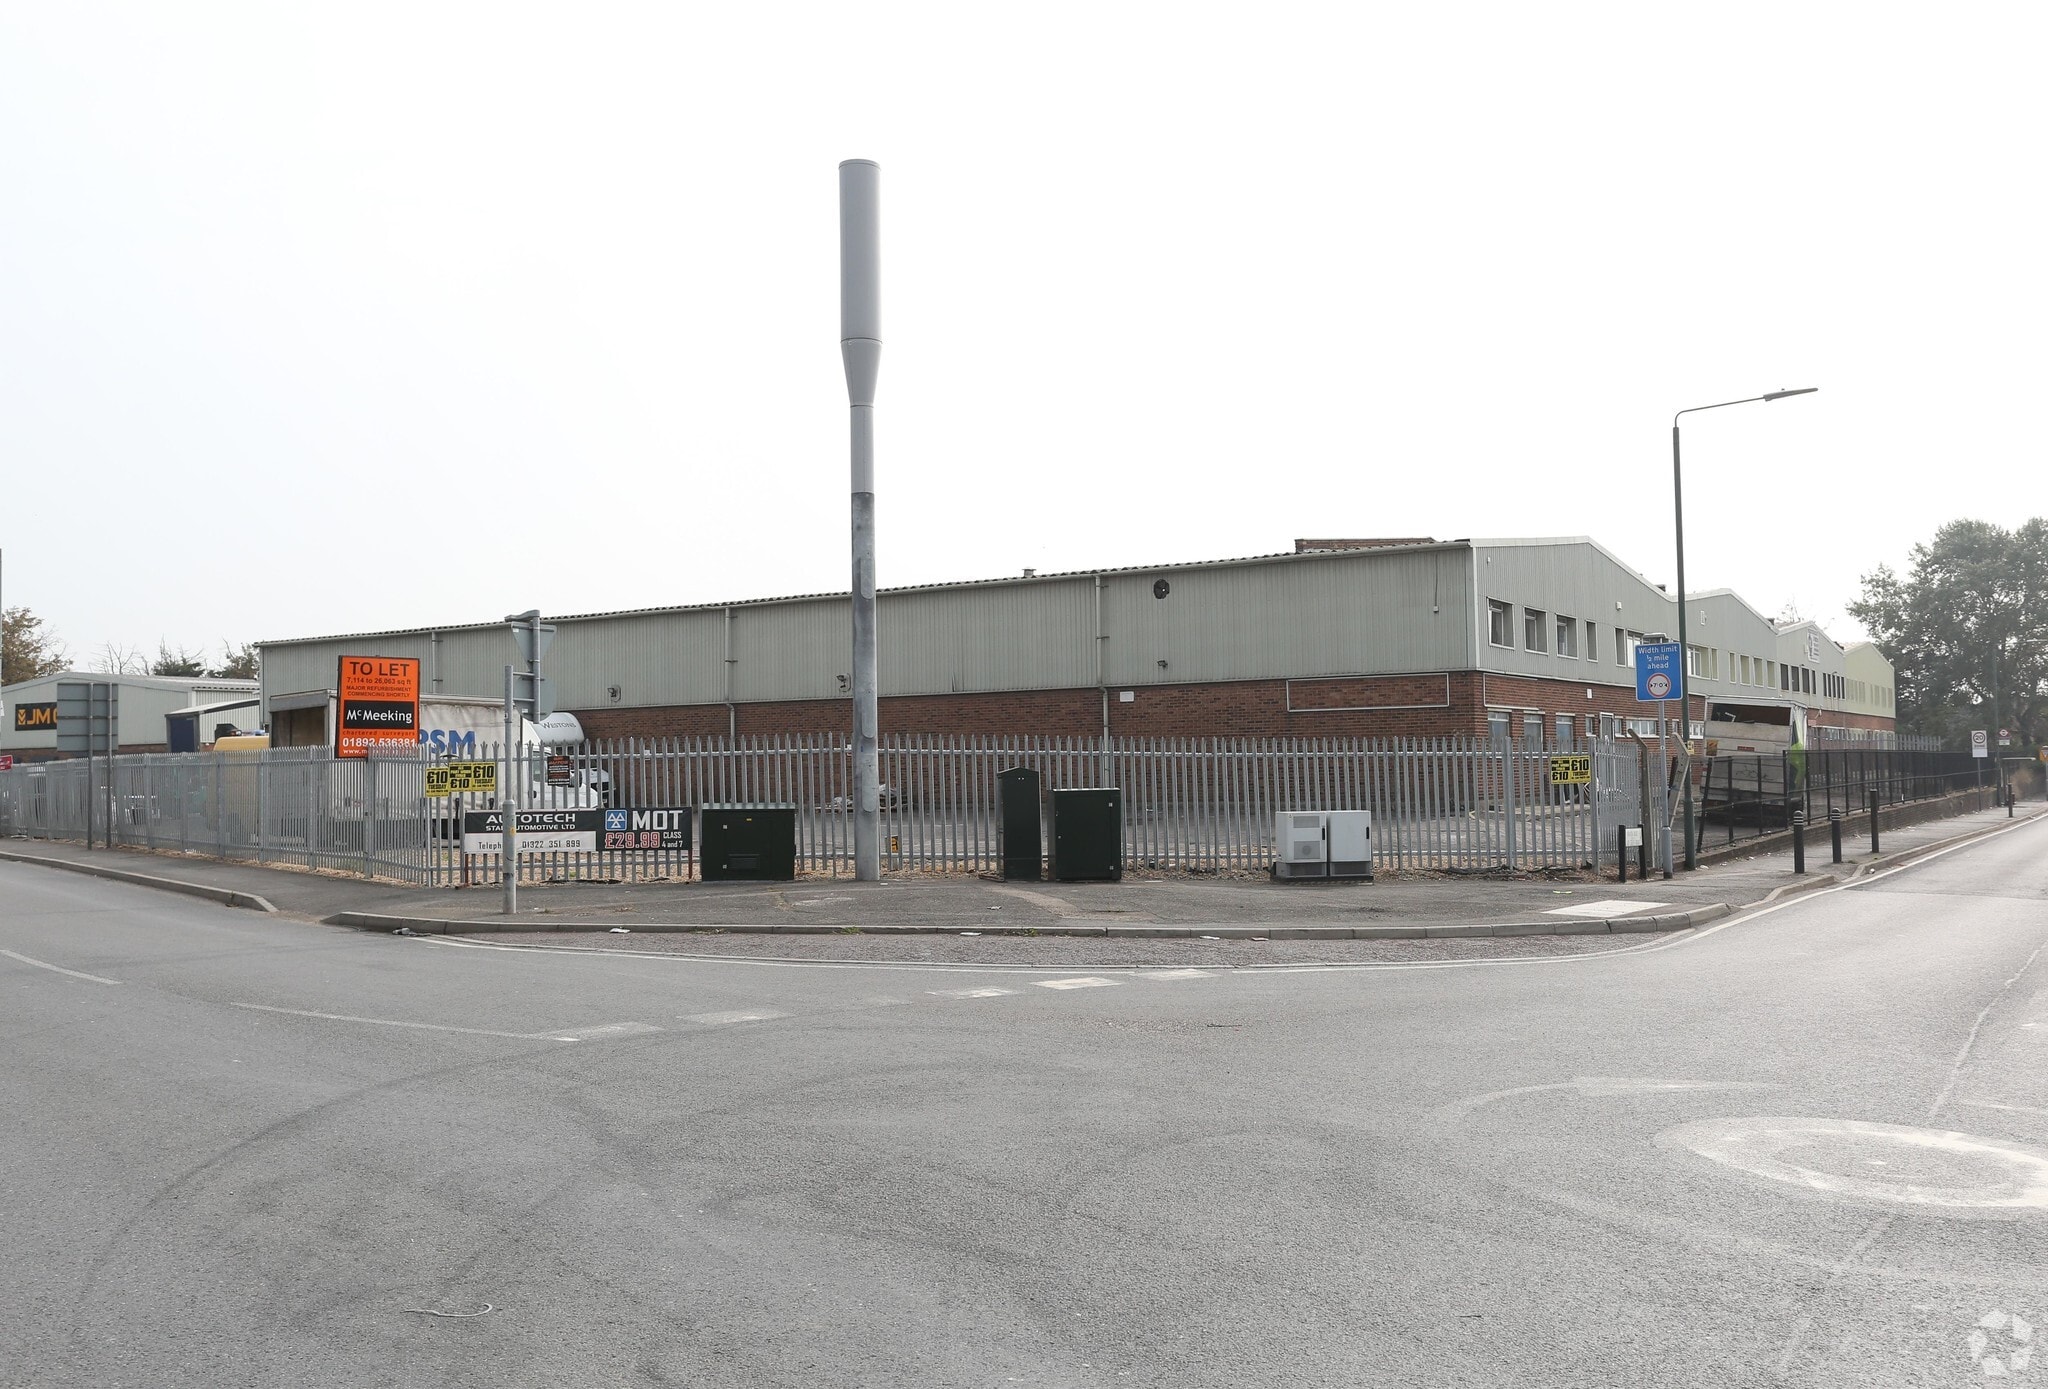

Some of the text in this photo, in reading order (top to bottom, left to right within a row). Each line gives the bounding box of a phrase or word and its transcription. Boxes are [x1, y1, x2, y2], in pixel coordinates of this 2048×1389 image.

[349, 661, 410, 677] TO LET
[1571, 759, 1589, 771] £10
[426, 771, 448, 784] £10
[473, 766, 495, 778] £10
[1552, 771, 1569, 781] £10
[450, 778, 470, 788] £10
[486, 813, 576, 824] AOTECH
[632, 810, 683, 831] MOT
[605, 831, 660, 849] £29.99
[663, 831, 682, 839] CLASS
[522, 840, 544, 849] 01322
[548, 840, 561, 848] 351
